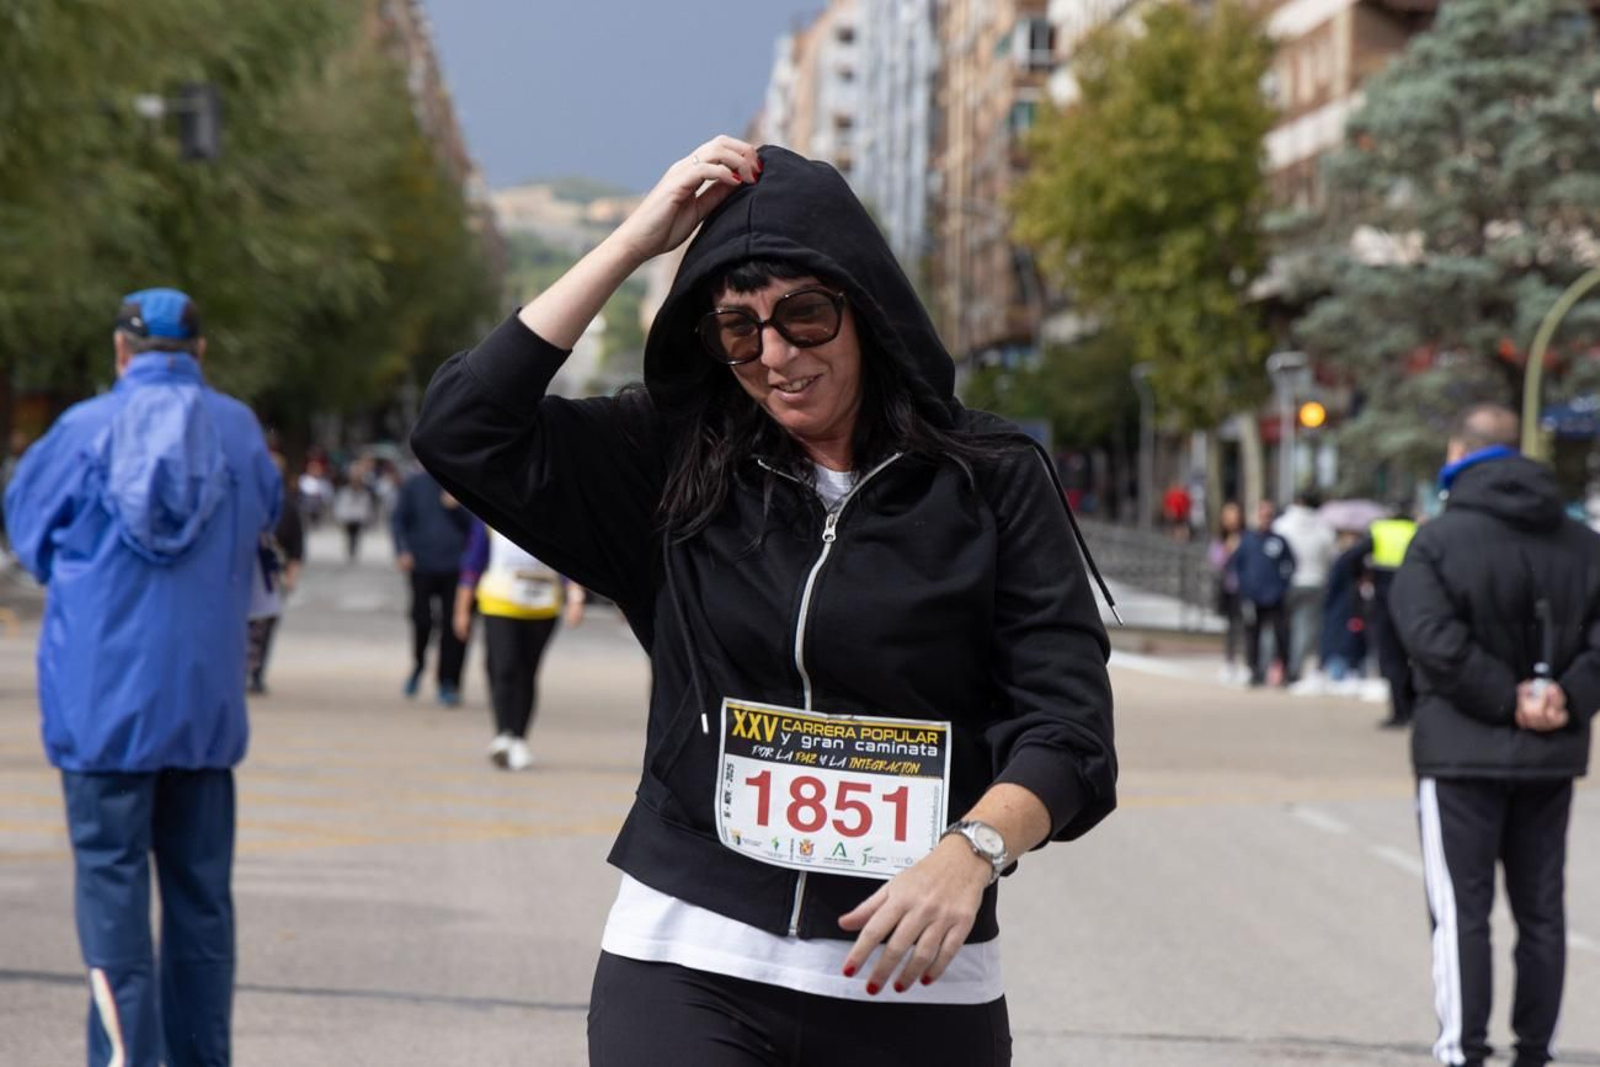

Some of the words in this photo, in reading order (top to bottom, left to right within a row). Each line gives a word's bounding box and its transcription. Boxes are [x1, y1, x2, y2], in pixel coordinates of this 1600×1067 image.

[731, 709, 778, 743] XXV
[781, 718, 856, 740] CARRERA
[860, 727, 938, 744] POPULAR
[751, 744, 775, 758] POR
[775, 748, 794, 762] LA
[794, 750, 818, 764] PAZ
[828, 755, 847, 768] LA
[780, 731, 792, 746] y
[801, 735, 844, 750] gran
[855, 740, 938, 757] caminata
[745, 769, 909, 842] 1851
